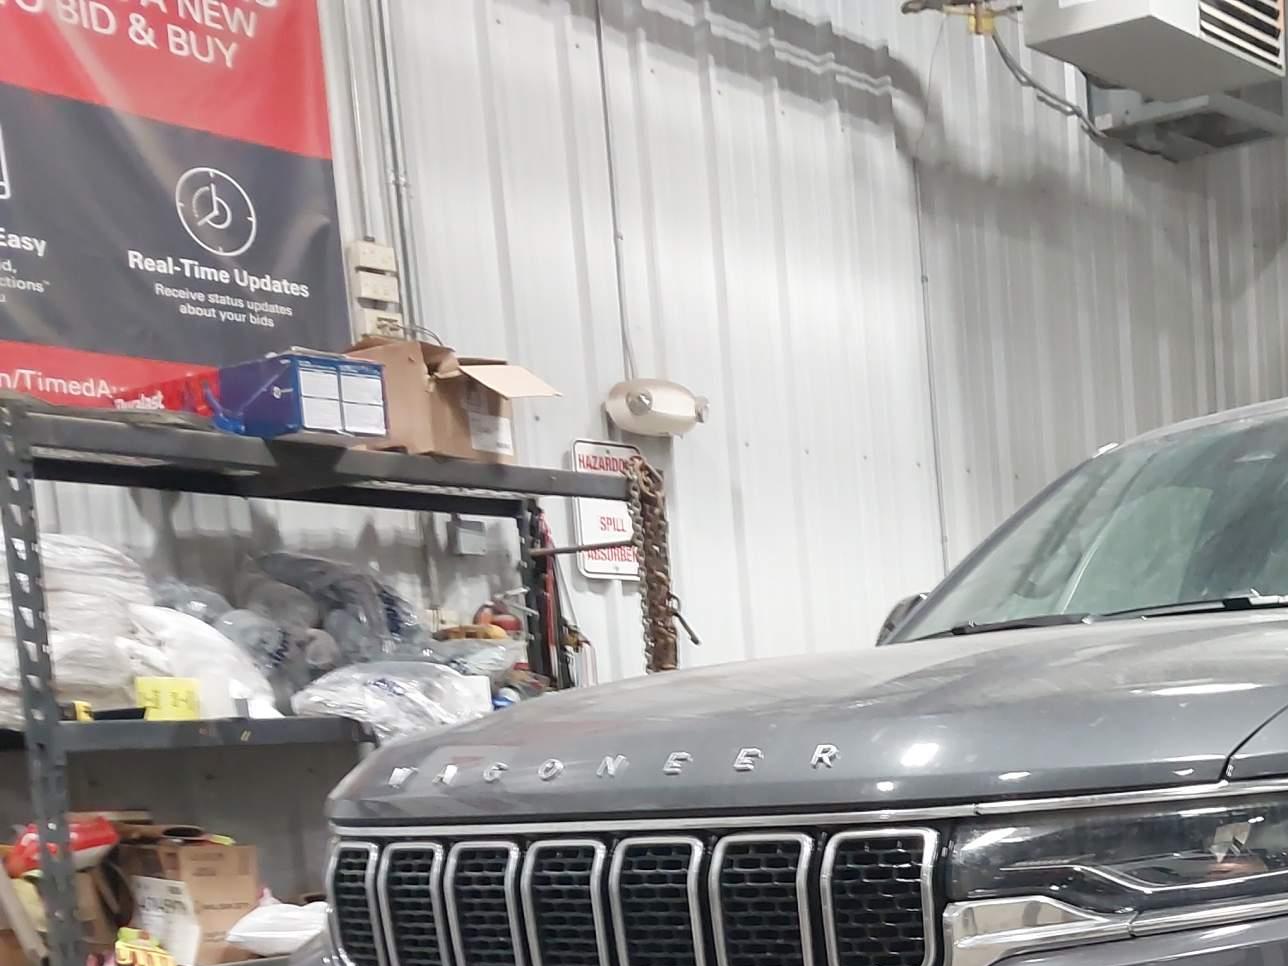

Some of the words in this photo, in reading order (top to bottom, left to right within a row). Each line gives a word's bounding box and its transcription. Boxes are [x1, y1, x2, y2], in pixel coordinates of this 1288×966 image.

[178, 0, 257, 38] NEW
[55, 0, 117, 35] BID
[127, 13, 159, 49] &
[167, 23, 238, 68] BUY
[128, 250, 230, 283] Real-Time
[233, 268, 310, 298] Updates
[154, 283, 206, 302] Receive
[208, 293, 244, 308] status
[247, 300, 293, 316] updates
[179, 303, 217, 318] about
[219, 310, 246, 322] your
[250, 313, 275, 327] bids
[578, 454, 626, 472] HAZARDO
[599, 516, 627, 532] SPILL
[587, 545, 640, 563] ABSORBEN
